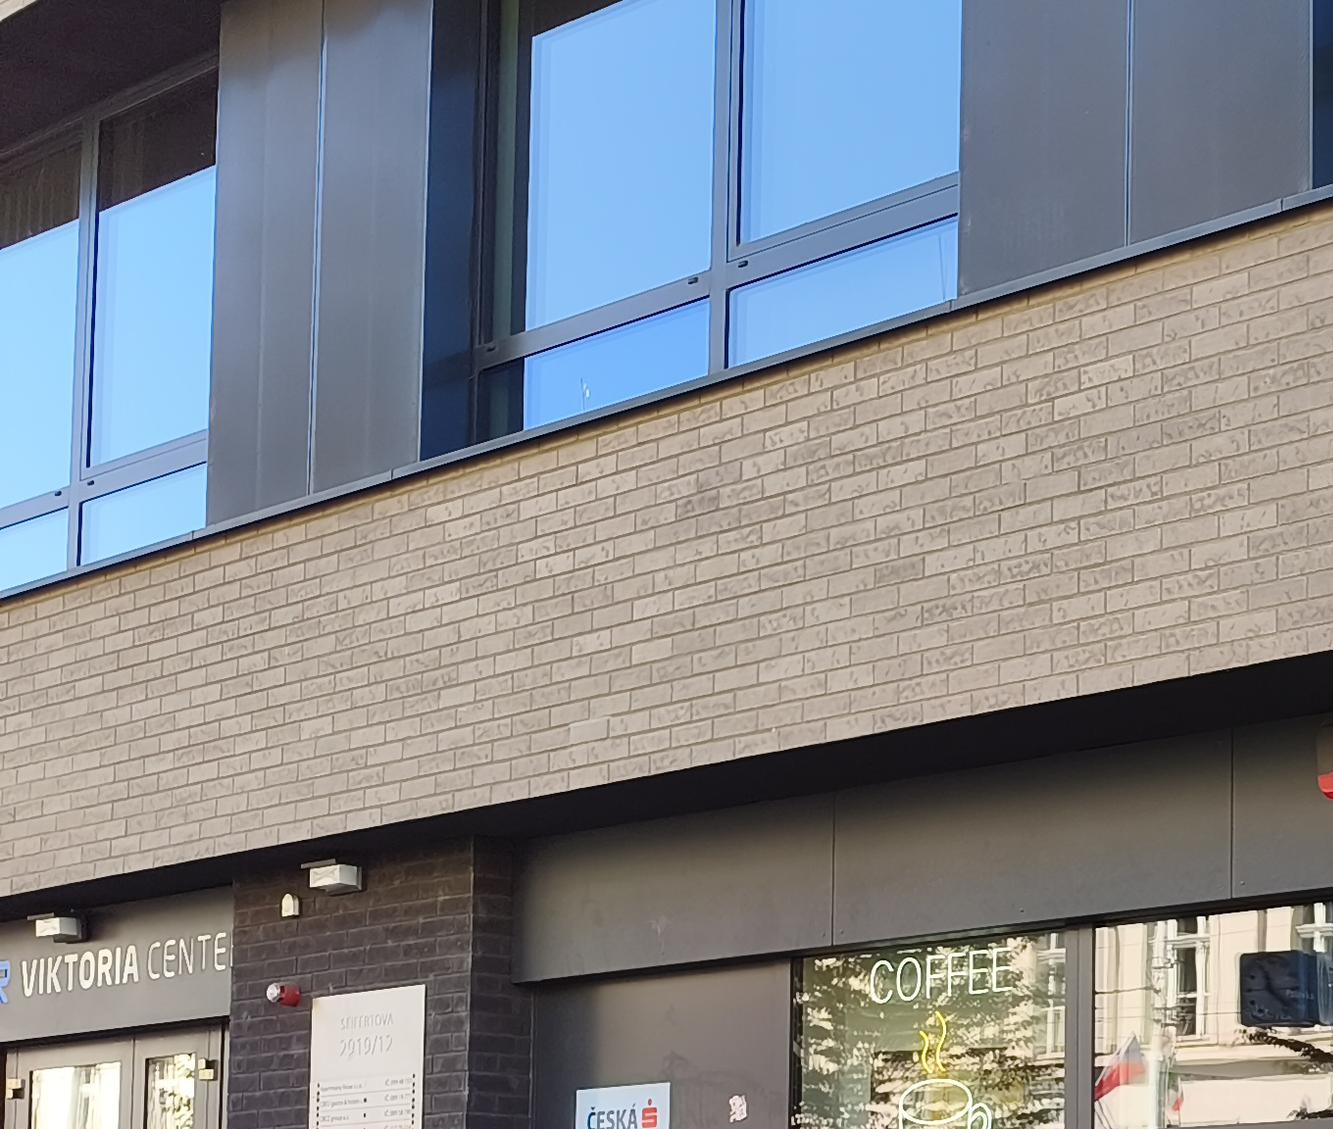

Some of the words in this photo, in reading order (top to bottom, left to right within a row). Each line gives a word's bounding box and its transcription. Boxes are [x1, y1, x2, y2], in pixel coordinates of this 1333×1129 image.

[21, 945, 140, 998] VIKTORIA
[147, 931, 234, 980] CENTE
[870, 947, 1013, 1005] COFFEE
